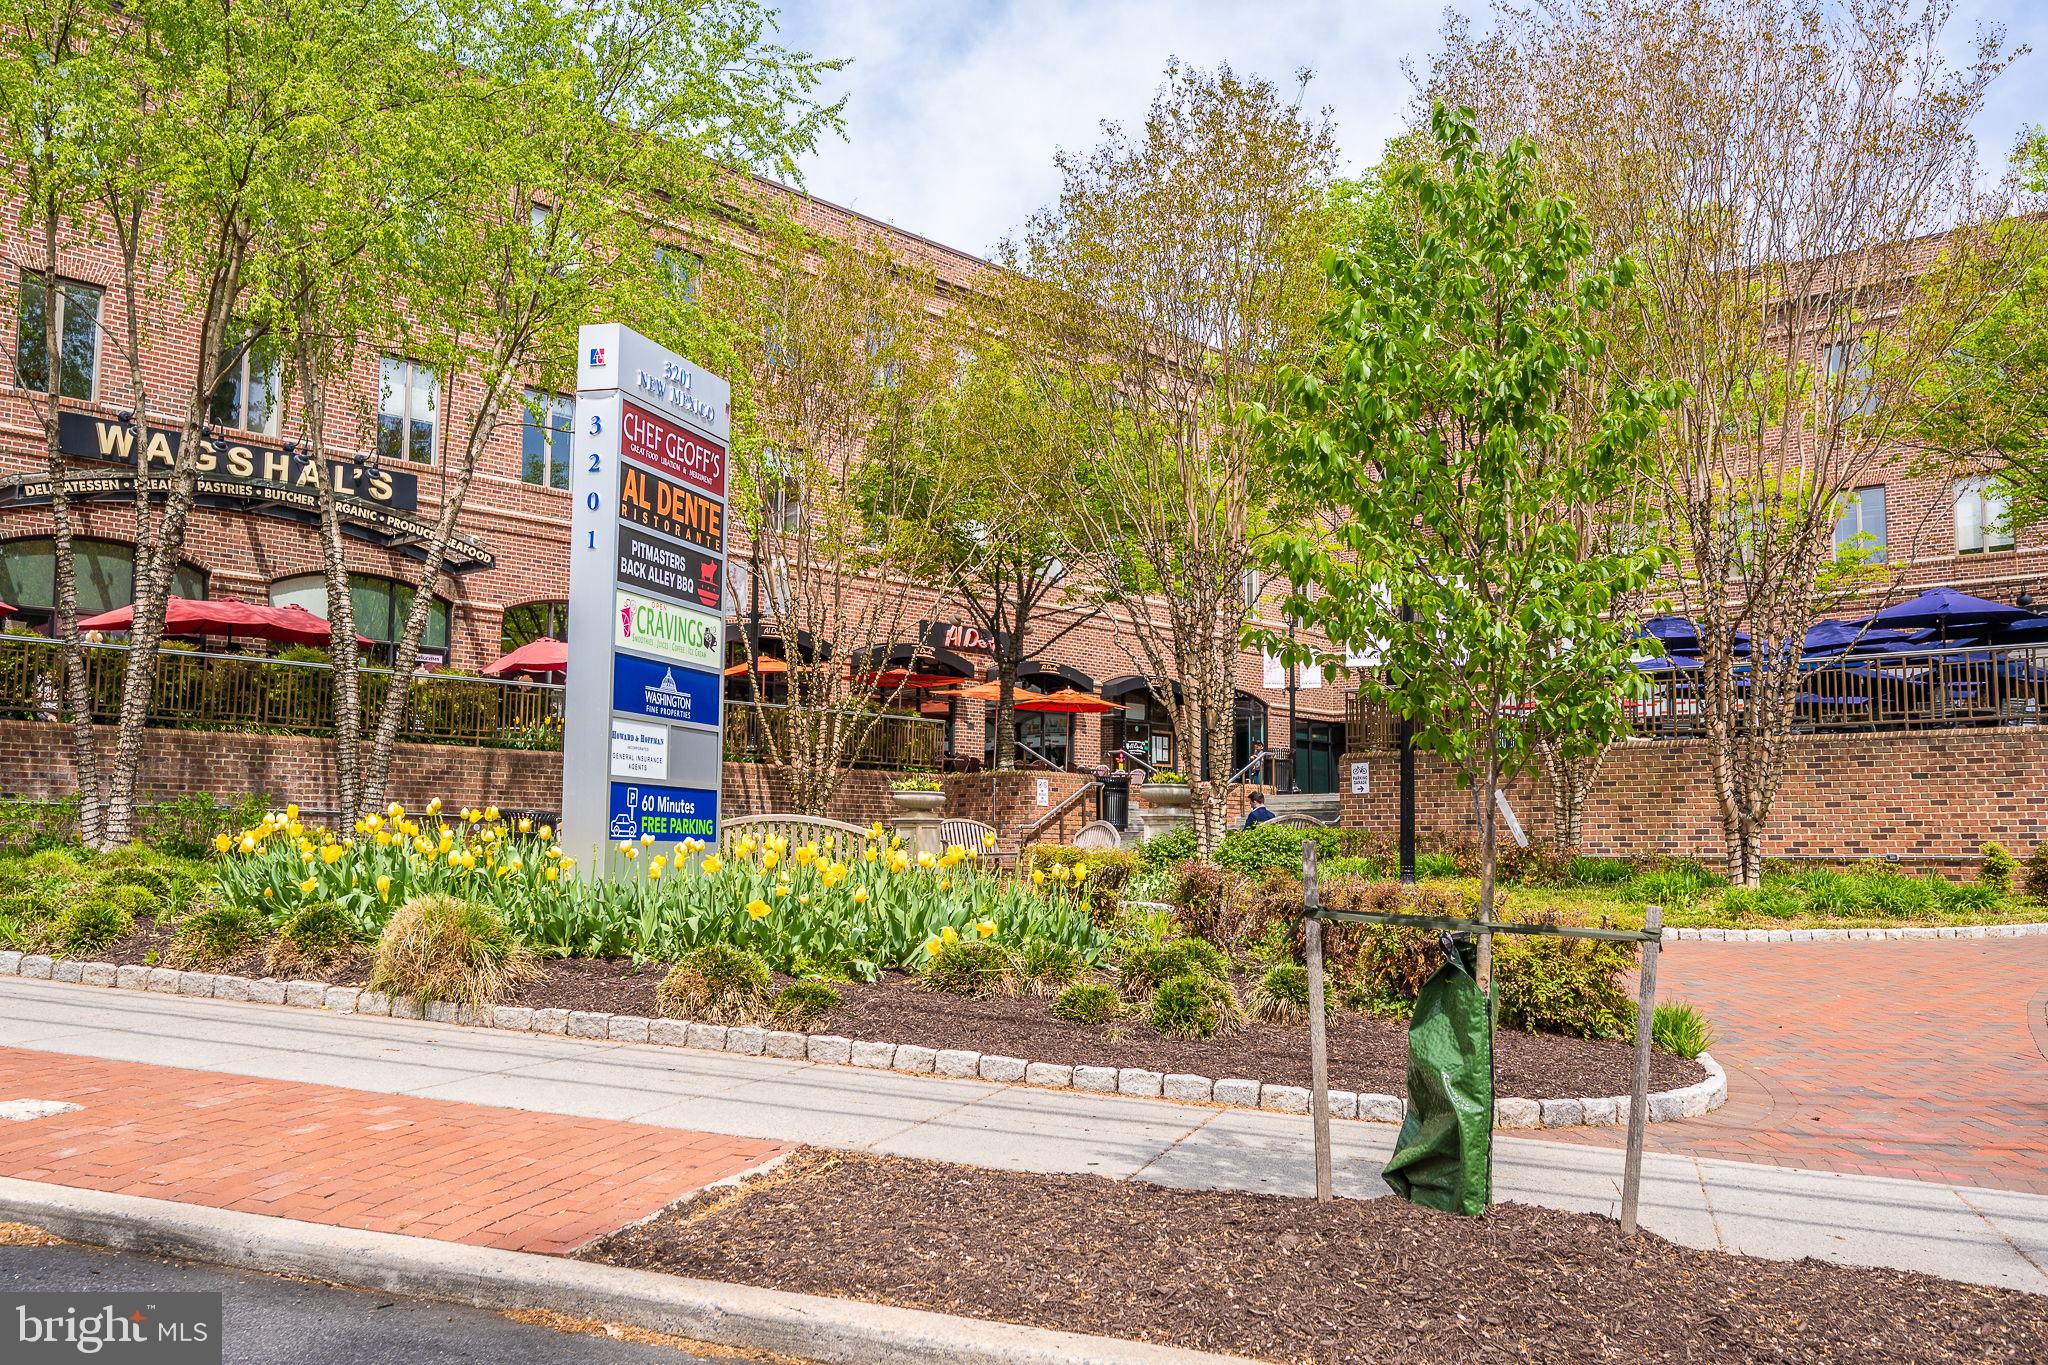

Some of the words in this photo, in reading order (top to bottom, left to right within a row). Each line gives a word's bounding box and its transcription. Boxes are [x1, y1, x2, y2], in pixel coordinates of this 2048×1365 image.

[663, 360, 692, 389] 3201
[637, 369, 666, 397] NEW
[671, 387, 715, 421] MEXICO
[623, 412, 664, 451] CHEF
[665, 433, 720, 478] GEOFF'S
[630, 443, 645, 455] GREAT
[645, 450, 658, 461] FOOD
[197, 481, 253, 496] PASTRIES
[264, 488, 315, 506] BUTCHER
[334, 501, 377, 521] RGANIC
[386, 515, 436, 540] PRODUCE
[622, 468, 651, 511] AL
[657, 480, 721, 537] DENTE
[621, 503, 720, 551] RISTORANTE
[631, 540, 686, 572] PITMASTERS
[620, 556, 647, 580] BACK
[647, 566, 676, 588] ALLEY
[676, 574, 694, 594] BBQ
[651, 601, 668, 611] OPEN
[636, 605, 703, 648] CRAVINGS
[645, 690, 691, 710] WASHINGTON
[646, 704, 659, 714] FINE
[660, 707, 691, 719] PROPERTIES
[611, 730, 635, 741] HOWARD
[612, 752, 635, 761] GENERAL
[635, 755, 663, 764] INSURANCE
[628, 763, 647, 771] AGENTS
[641, 794, 655, 812] 60
[657, 795, 695, 814] Minutes
[641, 816, 668, 833] FREE
[670, 817, 713, 835] PARKING
